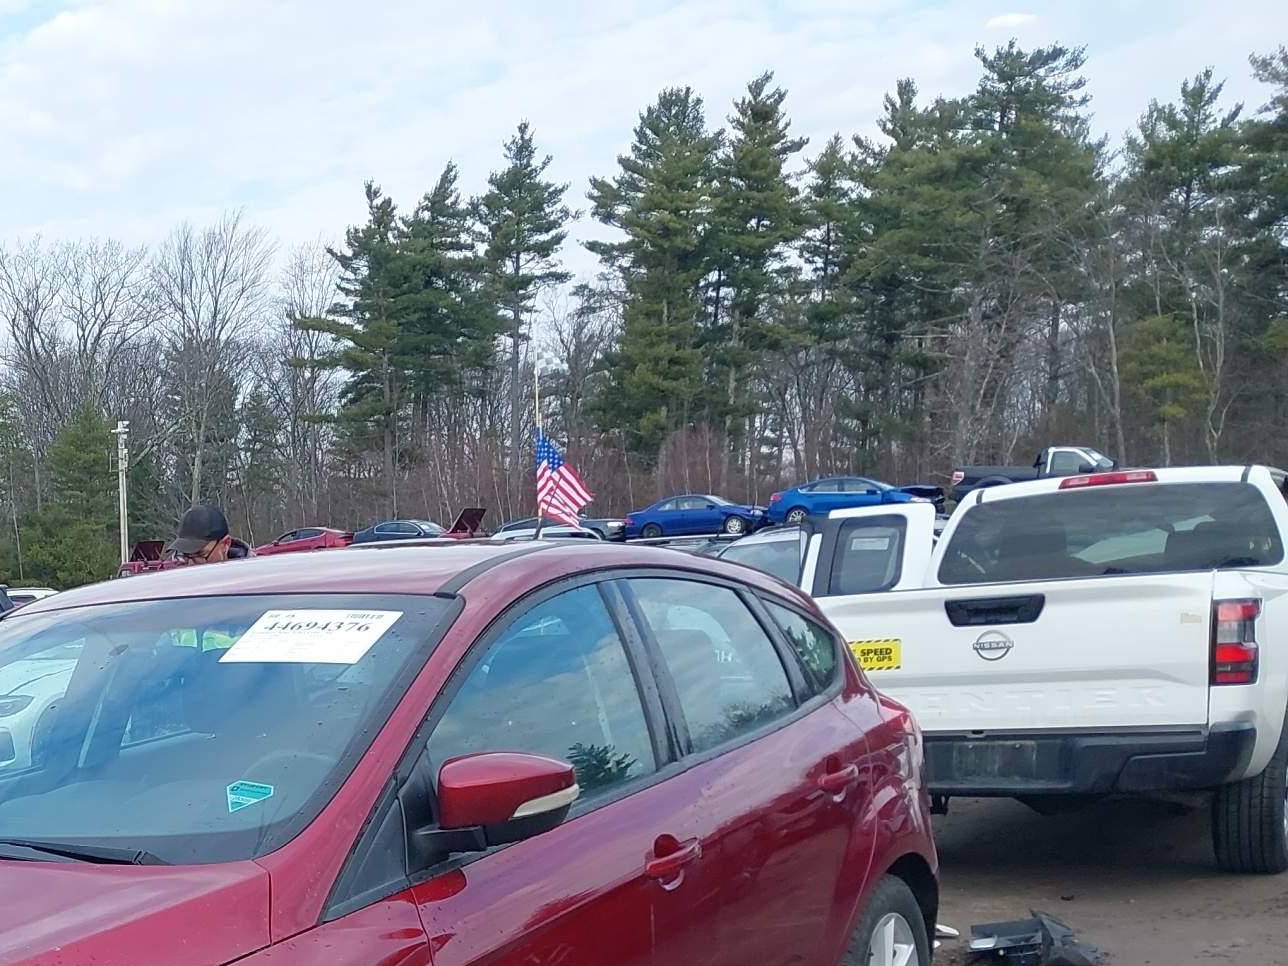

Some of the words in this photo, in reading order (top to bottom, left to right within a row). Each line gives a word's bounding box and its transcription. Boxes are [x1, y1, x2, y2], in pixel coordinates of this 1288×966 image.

[264, 621, 373, 632] 44694376
[973, 640, 1014, 650] NISSAN
[860, 648, 893, 656] SPEED
